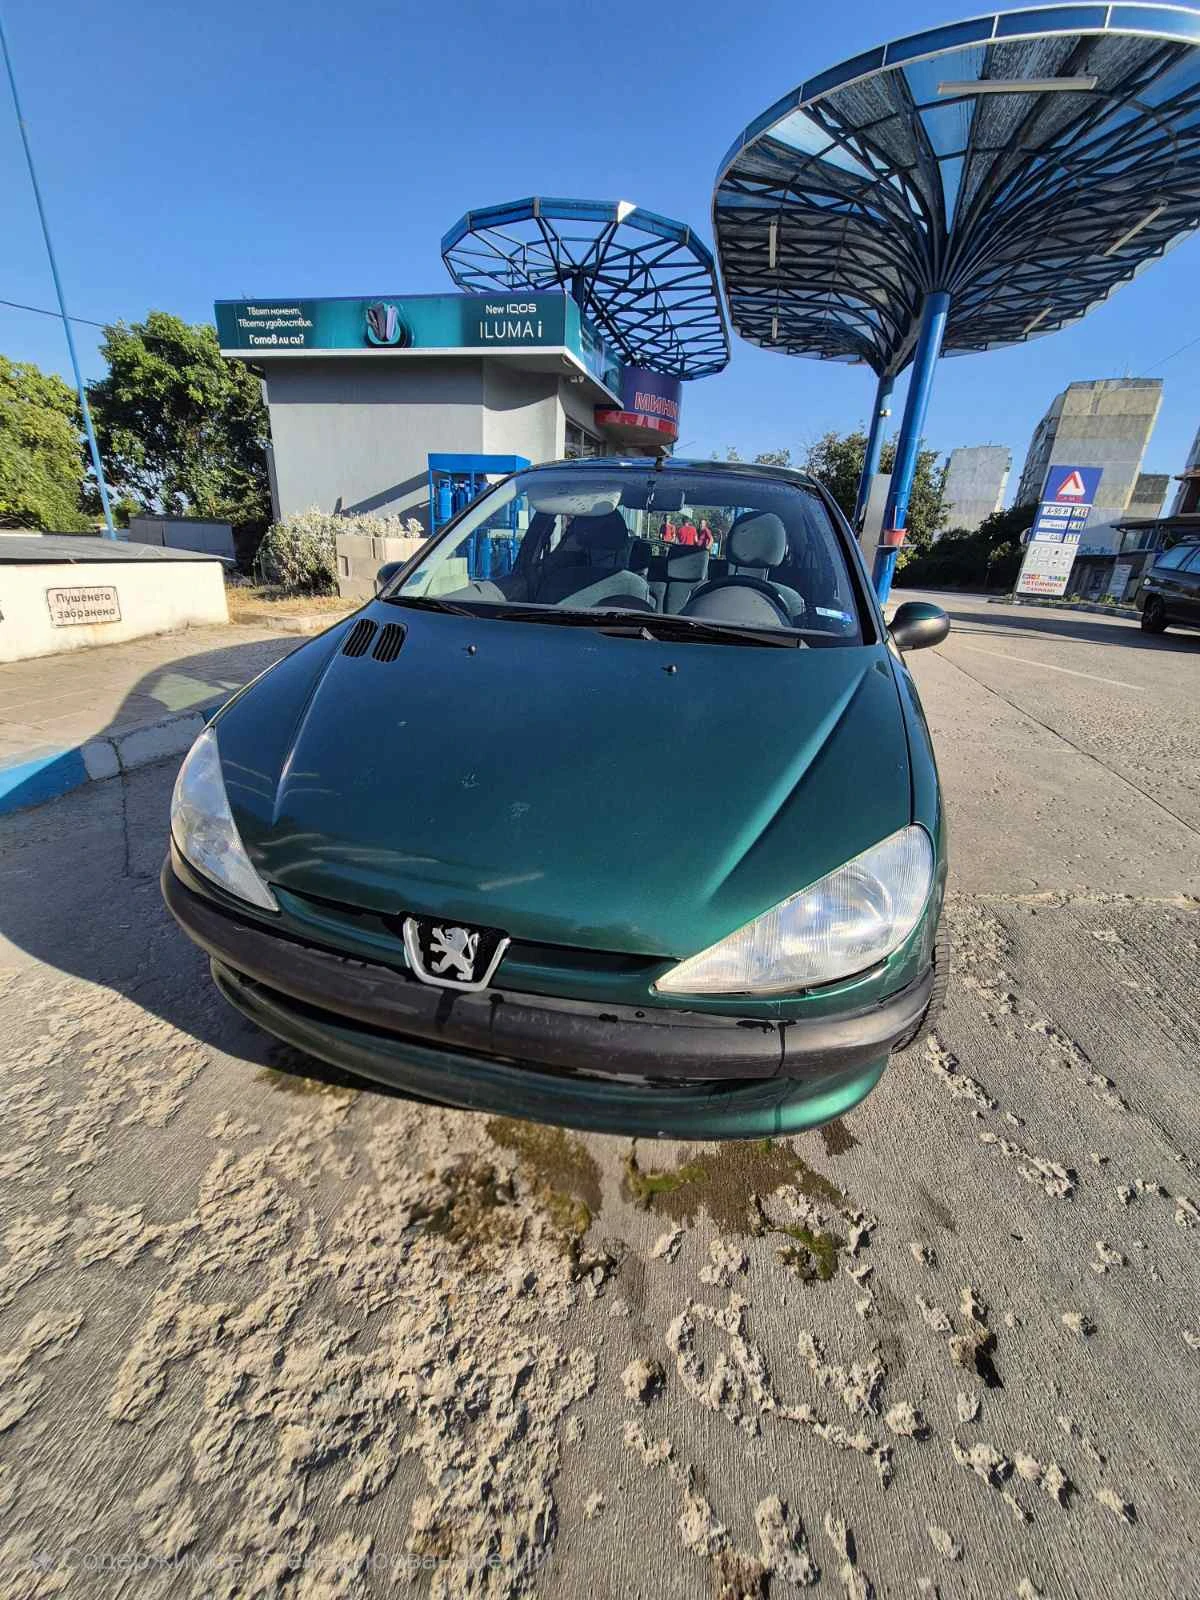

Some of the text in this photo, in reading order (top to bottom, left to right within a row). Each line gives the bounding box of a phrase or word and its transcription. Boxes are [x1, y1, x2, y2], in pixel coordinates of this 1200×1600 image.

[485, 303, 537, 315] New IQOS
[238, 318, 265, 328] Твоето
[480, 320, 534, 339] ILUMA
[249, 334, 305, 345] Готов ли си?
[55, 592, 112, 606] Пушенето
[56, 607, 117, 620] забранено
